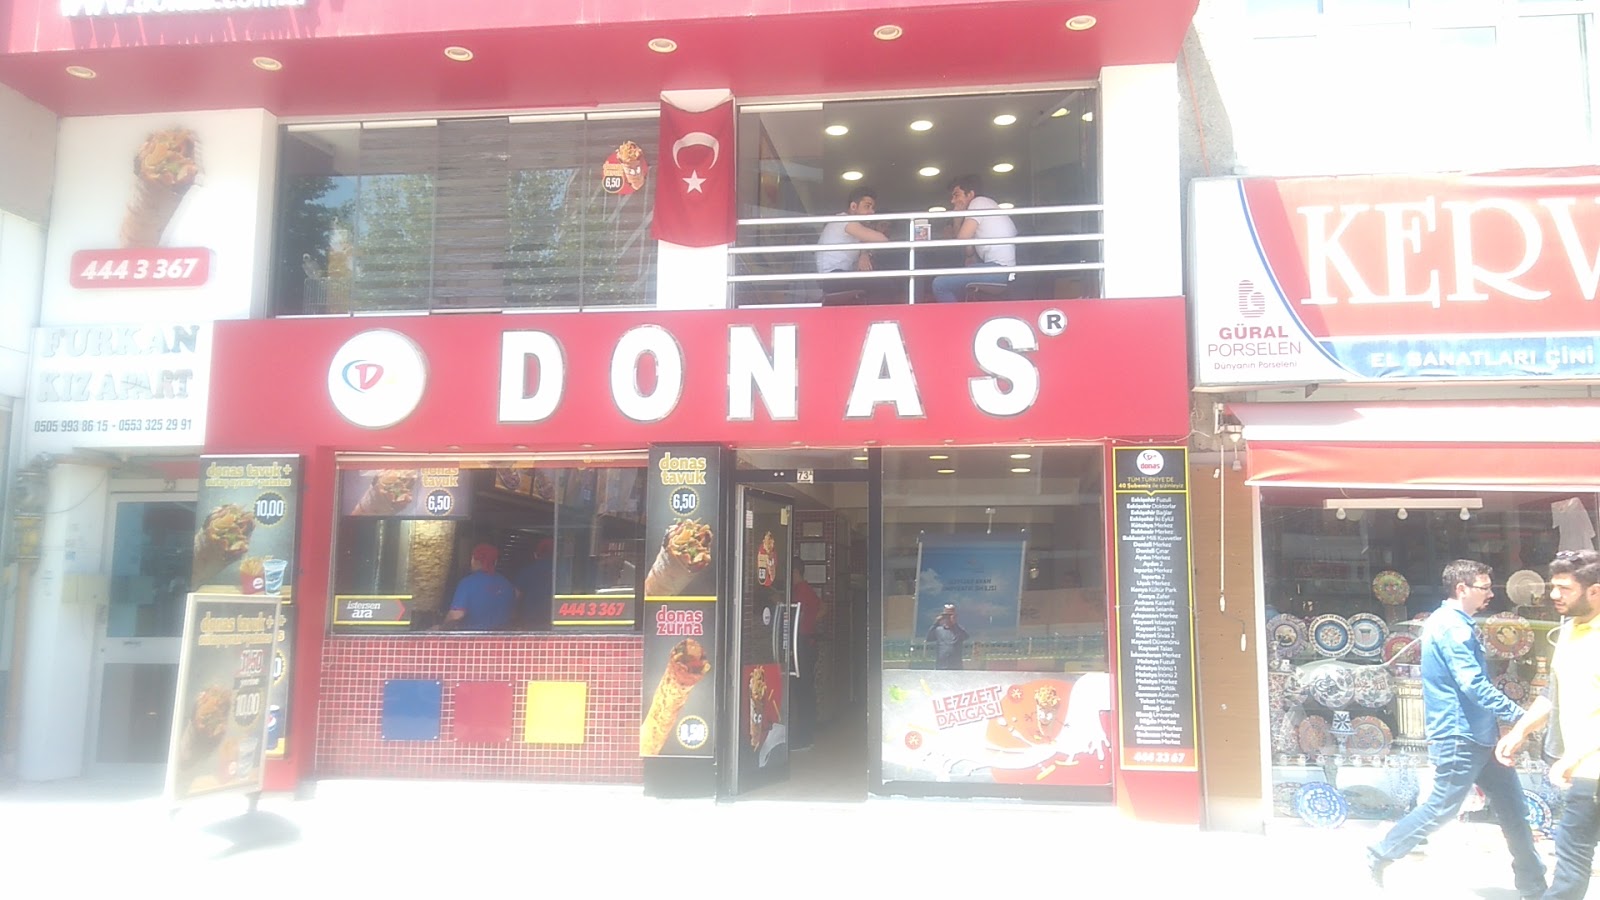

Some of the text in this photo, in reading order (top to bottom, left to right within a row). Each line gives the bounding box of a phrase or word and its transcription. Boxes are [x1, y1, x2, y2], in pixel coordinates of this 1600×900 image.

[604, 177, 621, 189] 6,50
[81, 258, 196, 281] 444 3 367
[1219, 323, 1289, 340] GÜRAL
[43, 325, 200, 358] FURKAN
[1208, 341, 1302, 357] PORSELEN
[1214, 360, 1298, 371] Dünyanın Porseleni
[1370, 353, 1400, 368] EL
[1405, 350, 1537, 367] SANATLARI
[497, 316, 1040, 423] DONAS
[37, 369, 194, 402] KIZ APART
[34, 420, 58, 433] 0505
[61, 420, 79, 432] 993
[82, 420, 94, 432] 86
[97, 420, 109, 432] 15
[118, 419, 142, 431] 0553
[145, 419, 164, 431] 325
[166, 419, 178, 431] 29
[181, 418, 193, 430] 91
[207, 462, 245, 478] donas
[246, 462, 282, 478] tavuk
[659, 452, 707, 471] donas
[422, 475, 460, 488] tavuk
[660, 470, 707, 485] tavuk
[256, 500, 285, 519] 10,00
[428, 495, 452, 512] 6,50
[673, 493, 697, 511] 6,50
[351, 609, 374, 618] ara
[559, 601, 625, 617] 444 3 367
[656, 605, 703, 623] donas
[657, 621, 703, 635] zurna
[932, 685, 999, 714] LEZZET
[936, 702, 1002, 727] DALGASI
